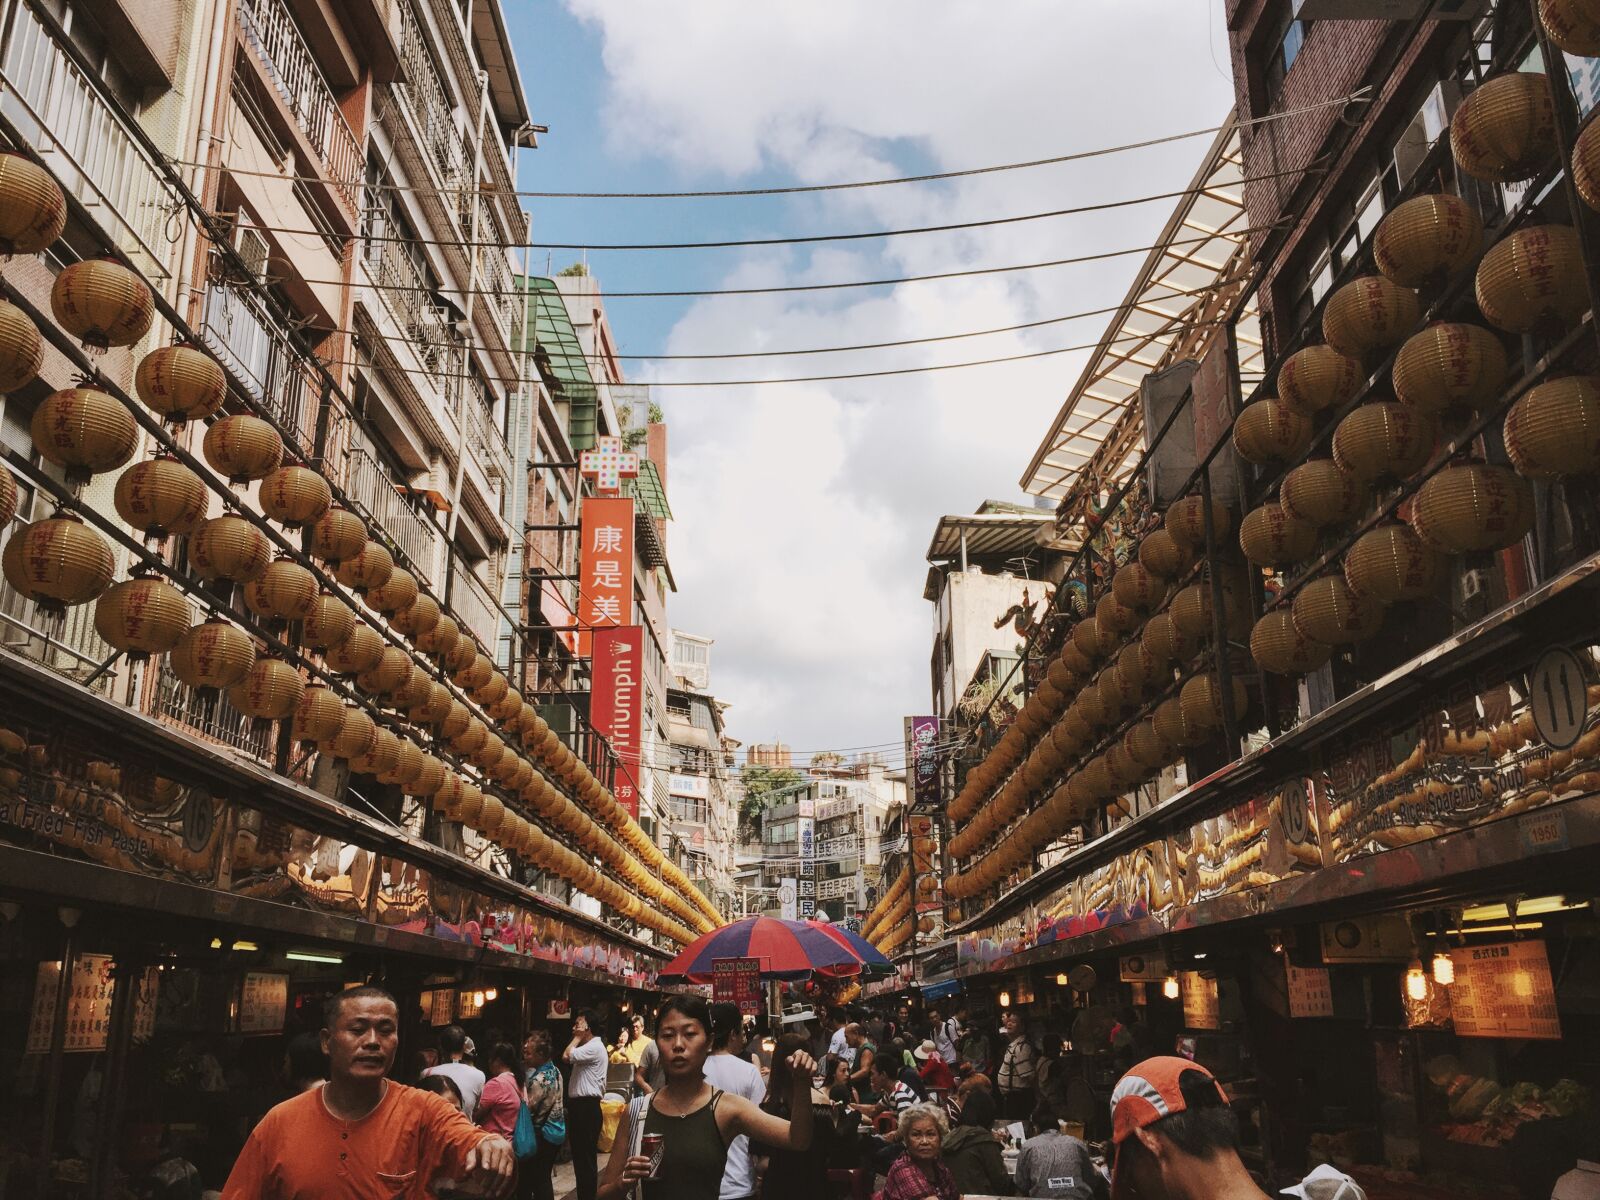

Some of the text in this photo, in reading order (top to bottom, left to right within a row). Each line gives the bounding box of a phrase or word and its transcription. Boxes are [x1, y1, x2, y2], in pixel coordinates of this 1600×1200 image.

[591, 525, 623, 625] 康是美
[609, 659, 637, 750] Triumph
[1543, 663, 1575, 733] 11
[1490, 765, 1525, 798] Soup
[73, 815, 103, 846] Fish
